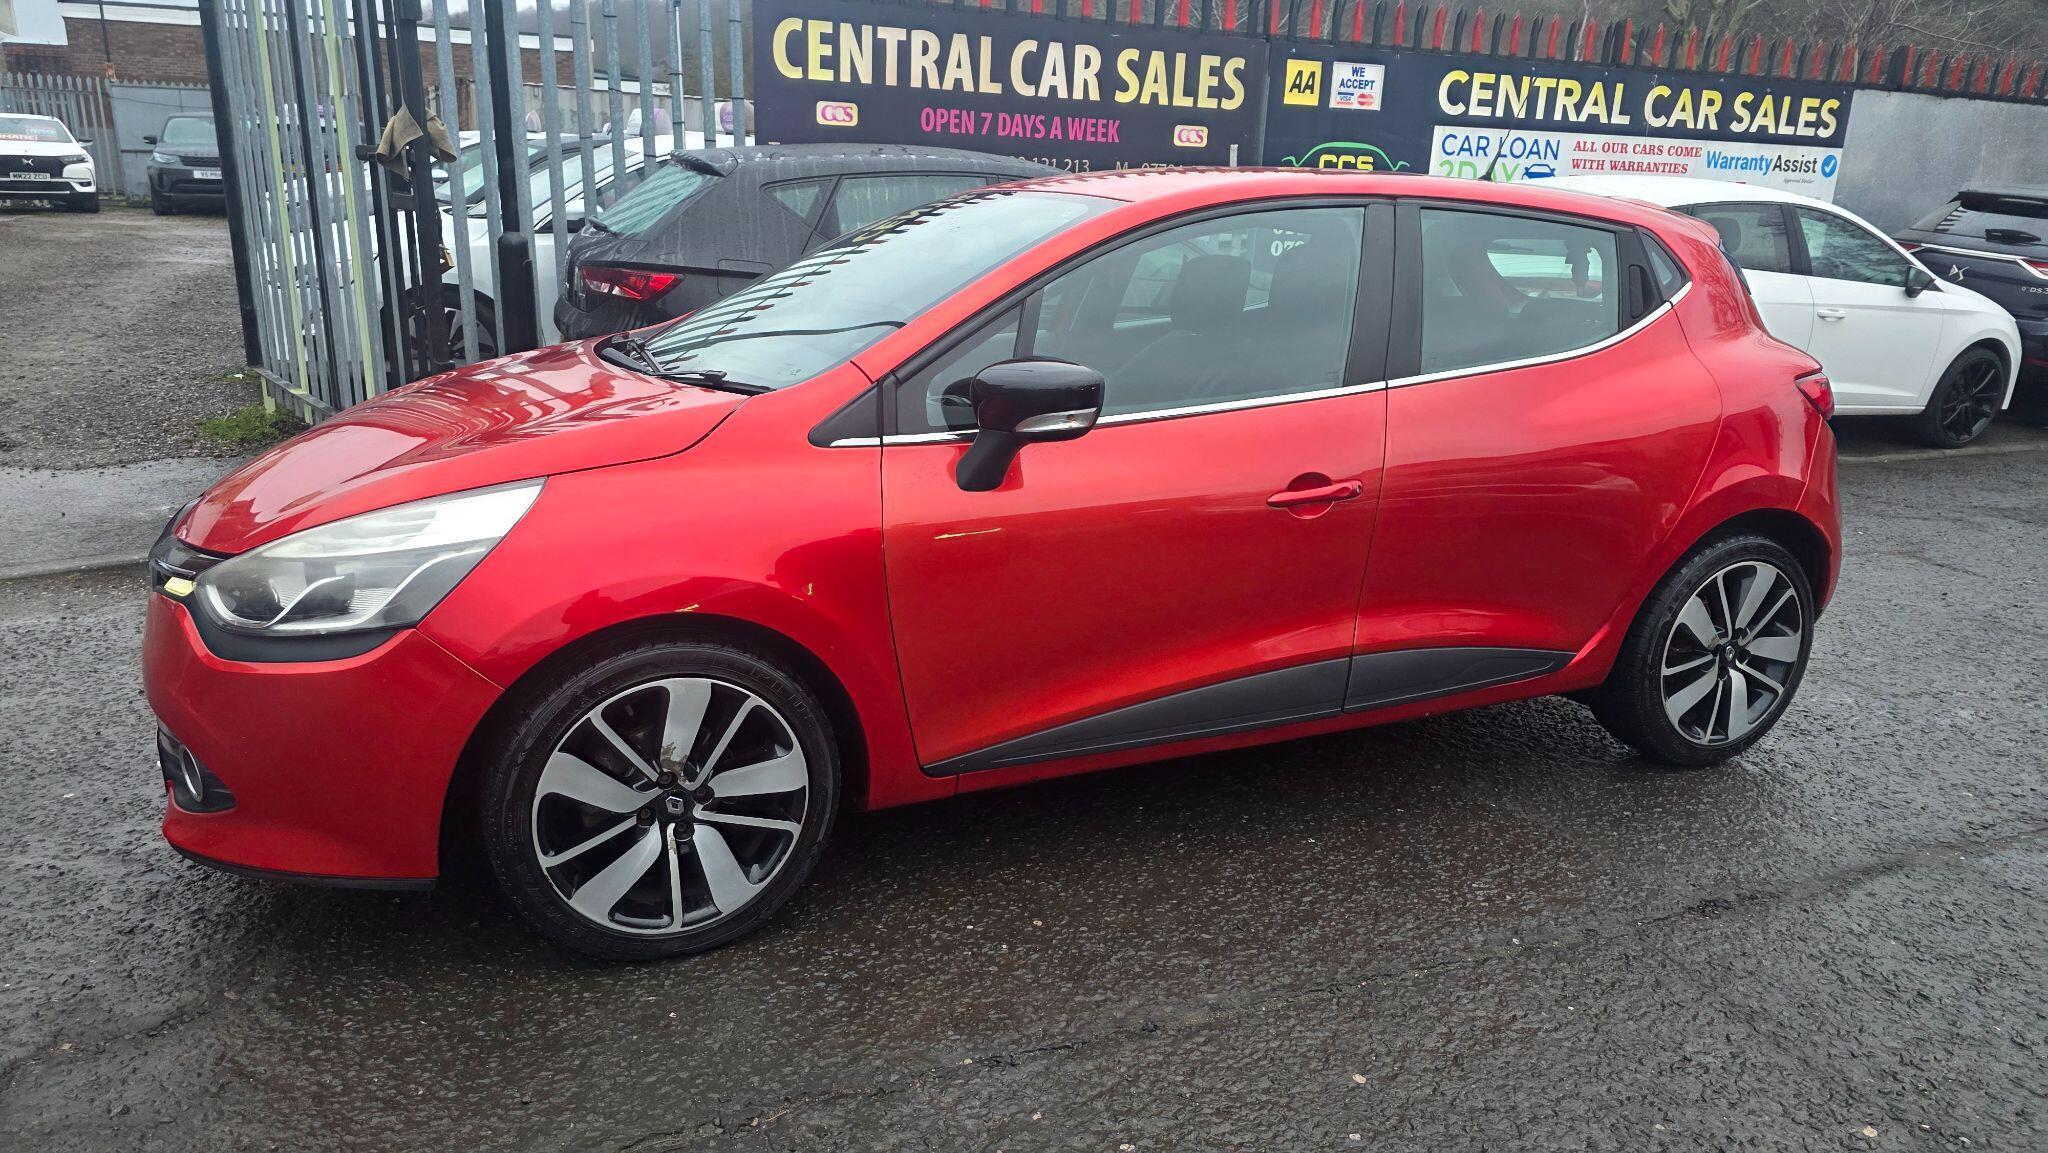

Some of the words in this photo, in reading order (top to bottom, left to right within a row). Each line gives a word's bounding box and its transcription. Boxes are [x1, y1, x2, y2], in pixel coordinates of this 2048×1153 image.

[773, 17, 1002, 94] CENTRAL
[1010, 39, 1102, 101] CAR
[1114, 48, 1246, 110] SALES
[1352, 66, 1366, 77] WE
[1289, 70, 1316, 94] AA
[1339, 78, 1375, 90] ACCEPT
[1438, 70, 1631, 125] CENTRAL
[1644, 85, 1723, 131] CAR
[1729, 91, 1841, 139] SALES
[920, 107, 975, 135] OPEN
[981, 112, 993, 136] 7
[998, 112, 1046, 139] DAYS
[1050, 116, 1063, 140] A
[1068, 116, 1121, 143] WEEK
[1441, 133, 1490, 157] CAR
[1498, 136, 1560, 160] LOAN
[1573, 140, 1597, 153] ALL
[1602, 141, 1628, 154] OUR
[1632, 143, 1664, 156] CARS
[1667, 145, 1703, 158] COME
[1571, 158, 1606, 171] WITH
[1610, 160, 1689, 174] WARRANTIES
